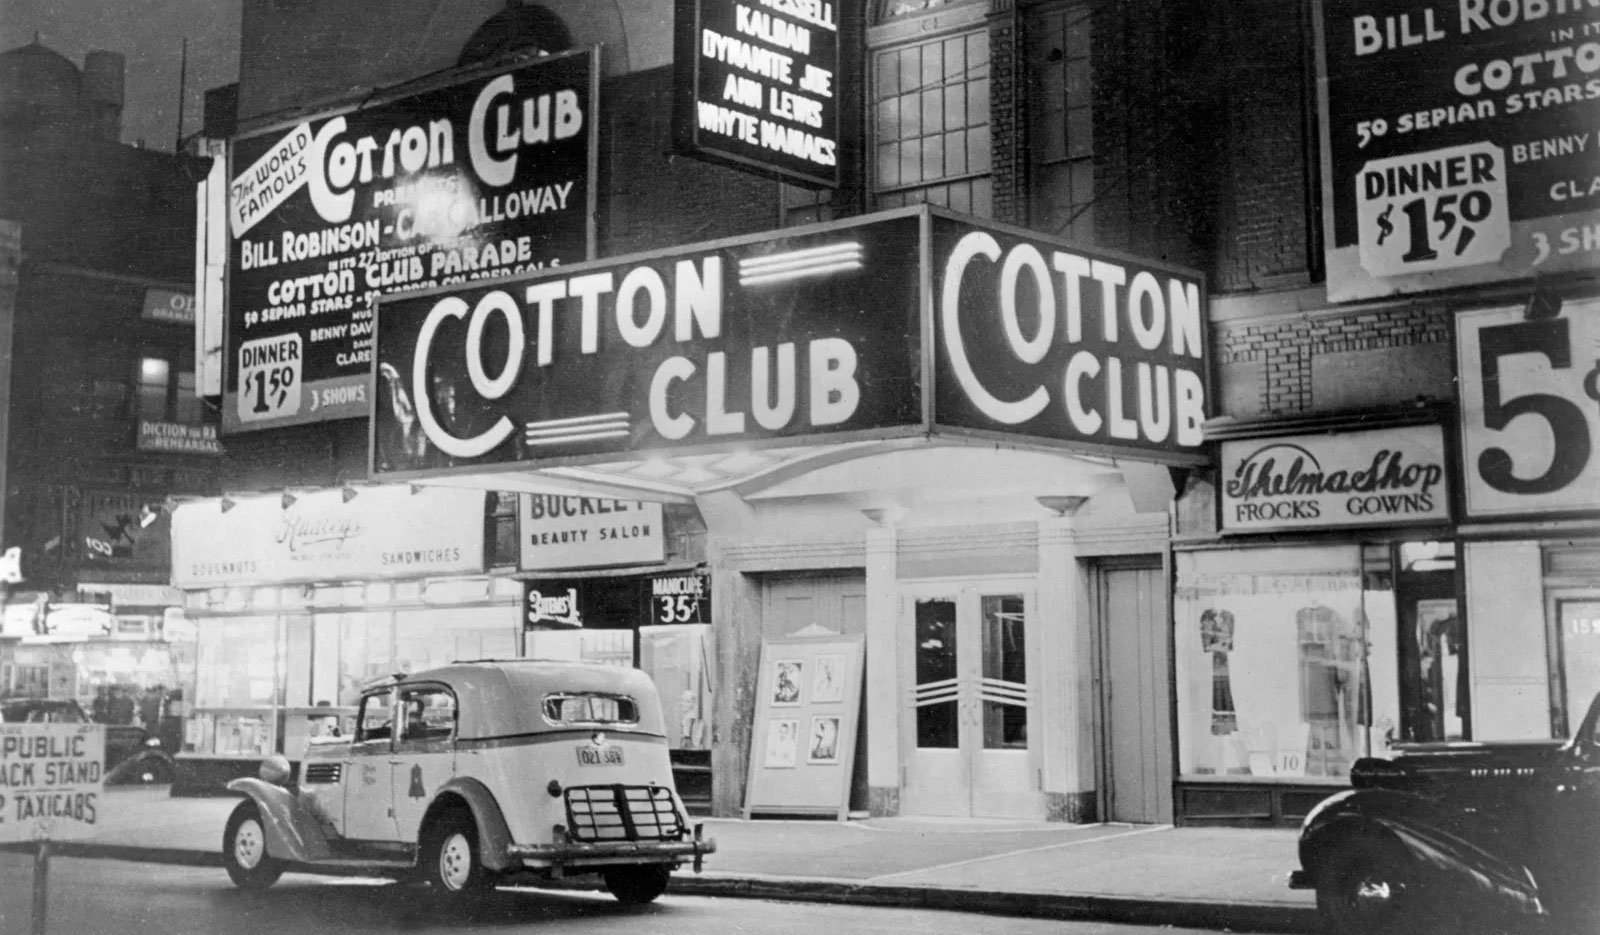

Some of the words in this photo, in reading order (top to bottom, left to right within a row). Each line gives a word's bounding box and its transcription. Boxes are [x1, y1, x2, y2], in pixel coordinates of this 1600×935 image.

[1354, 8, 1445, 56] BILL
[1552, 27, 1574, 43] IN
[702, 28, 793, 85] DYNAMITE
[1454, 42, 1600, 96] COTTO
[697, 101, 759, 145] WHYTE
[769, 87, 823, 129] LEWIS
[1356, 119, 1388, 149] 50
[1396, 99, 1496, 133] SEPIAN
[1505, 78, 1600, 114] STARS
[468, 74, 582, 187] CLUB
[1512, 133, 1589, 164] BENNY
[255, 133, 307, 185] WORLD
[1365, 153, 1496, 200] DINNER
[238, 157, 306, 223] FAMOUS
[241, 240, 278, 270] BILL
[282, 219, 380, 263] ROBINSON
[1531, 231, 1551, 266] 3
[268, 269, 355, 306] COTTON
[365, 256, 424, 288] CLUB
[430, 236, 532, 277] PARADE
[244, 311, 259, 329] 50
[261, 303, 306, 323] SEPIAN
[310, 294, 353, 315] STARS
[310, 325, 348, 342] BENNY
[942, 231, 1202, 424] COTTON
[242, 340, 299, 369] DINNER
[413, 255, 722, 458] COTTON
[648, 337, 860, 441] CLUB
[1065, 351, 1204, 447] CLUB
[142, 421, 187, 437] DICTION
[1236, 500, 1321, 522] FROCKS
[1346, 494, 1434, 516] GOWNS
[381, 548, 461, 566] SANDWICHES
[532, 529, 588, 546] BEAUTY
[600, 525, 650, 541] SALON
[4, 735, 85, 759] PUBLIC
[45, 761, 100, 785] STAND
[14, 793, 97, 825] TAXICABS
